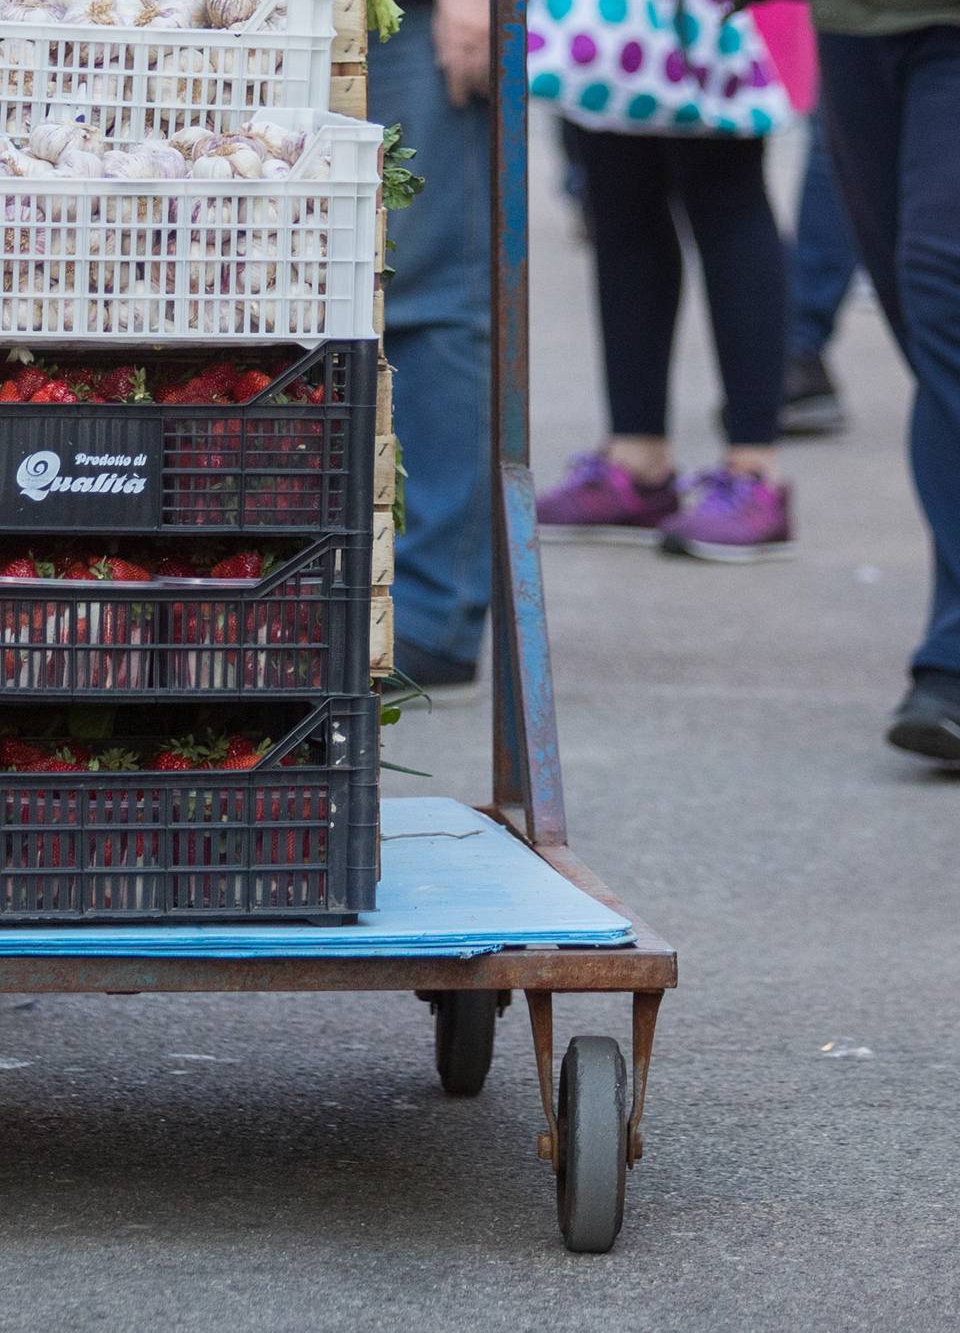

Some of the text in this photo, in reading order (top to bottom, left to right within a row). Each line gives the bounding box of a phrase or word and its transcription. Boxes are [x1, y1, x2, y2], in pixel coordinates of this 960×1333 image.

[74, 453, 147, 466] Prodotto di
[16, 450, 147, 502] Qualità
